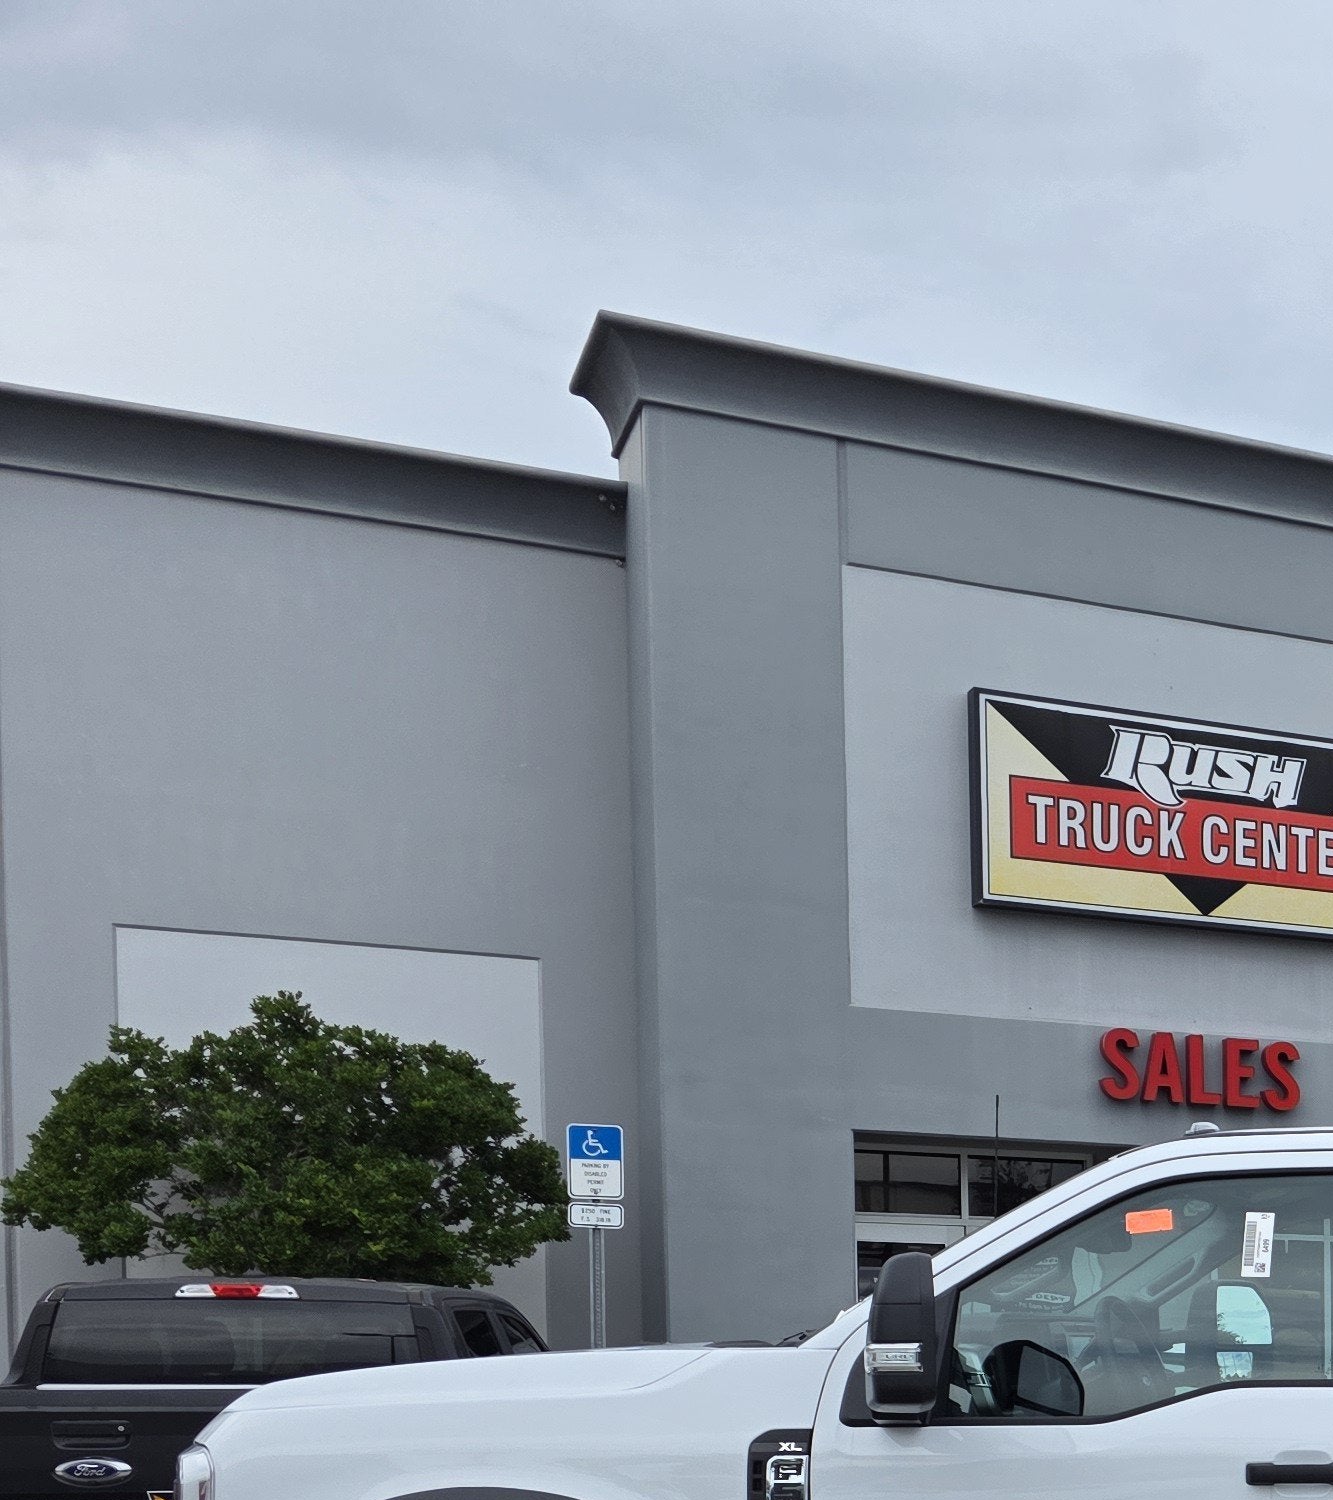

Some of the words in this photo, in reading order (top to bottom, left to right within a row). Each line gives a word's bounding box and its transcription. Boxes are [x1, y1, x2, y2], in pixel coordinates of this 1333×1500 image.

[1026, 793, 1187, 860] TRUCK
[1098, 1027, 1301, 1112] SALES
[778, 1441, 803, 1452] XL
[73, 1463, 106, 1477] Ford
